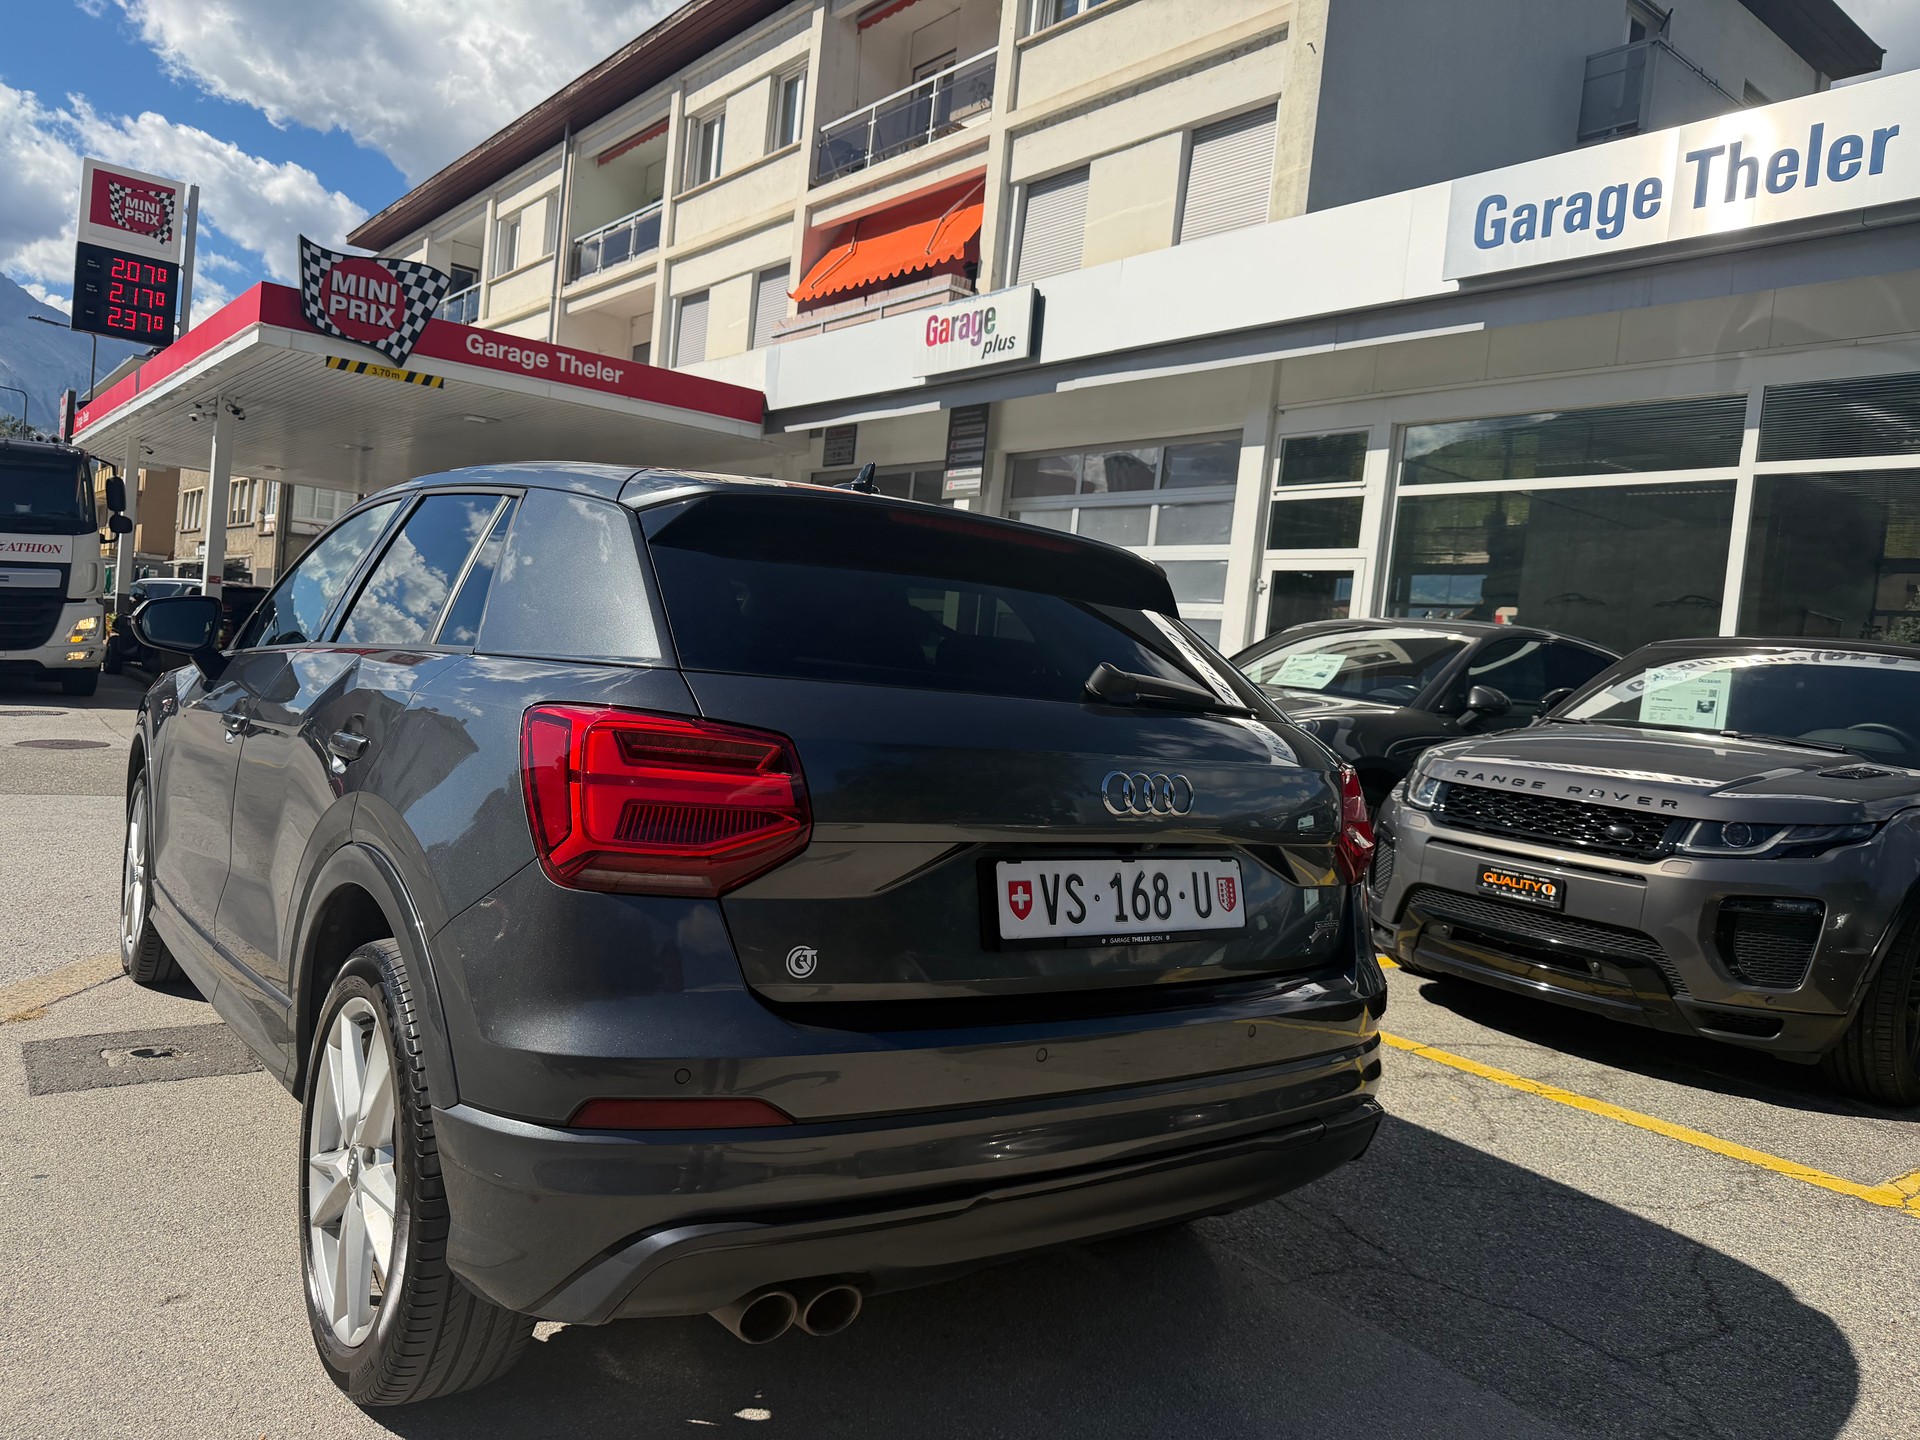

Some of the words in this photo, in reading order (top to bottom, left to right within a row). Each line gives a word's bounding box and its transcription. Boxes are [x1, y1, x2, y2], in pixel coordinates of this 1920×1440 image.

[1474, 176, 1663, 250] Garage
[1685, 121, 1900, 210] Theler
[124, 208, 160, 226] PRIX
[125, 196, 161, 214] MINI
[331, 270, 398, 305] MINI
[329, 294, 397, 329] PRIX
[925, 305, 997, 347] Garage
[465, 332, 550, 371] Garage
[555, 351, 625, 384] Theler
[981, 335, 1016, 359] plus
[5, 542, 63, 554] ATHION
[1454, 769, 1546, 790] RANGE
[1566, 785, 1679, 809] ROVER
[1483, 872, 1542, 892] QUALITY
